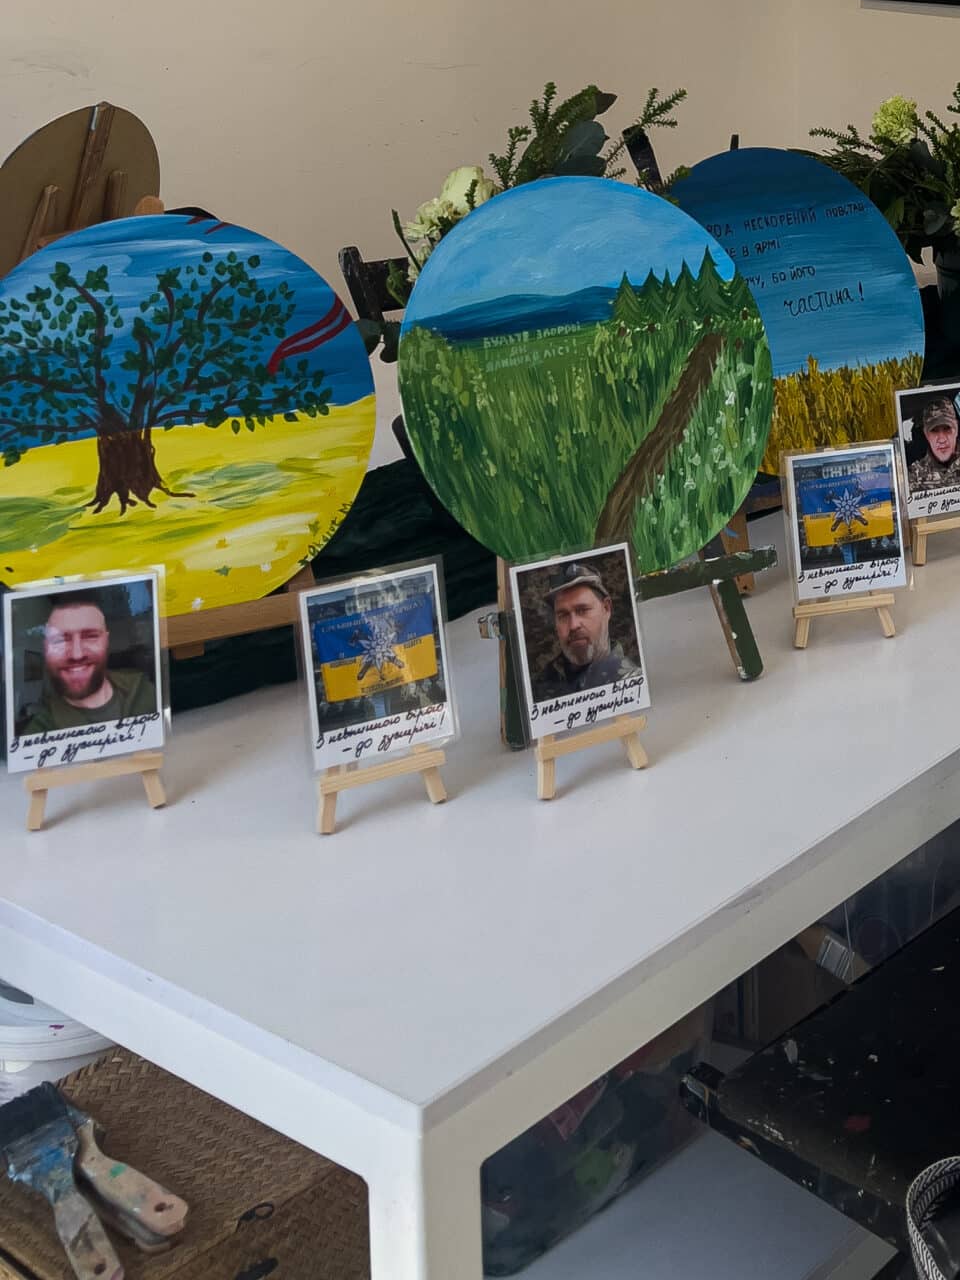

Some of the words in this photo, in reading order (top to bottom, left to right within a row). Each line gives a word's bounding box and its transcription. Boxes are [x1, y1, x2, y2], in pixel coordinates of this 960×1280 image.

[743, 207, 818, 231] НЕСКОРЕНИЙ
[742, 245, 750, 257] В
[755, 239, 781, 255] ЯРМІ
[772, 272, 786, 283] БО
[790, 265, 816, 281] ЙОГО
